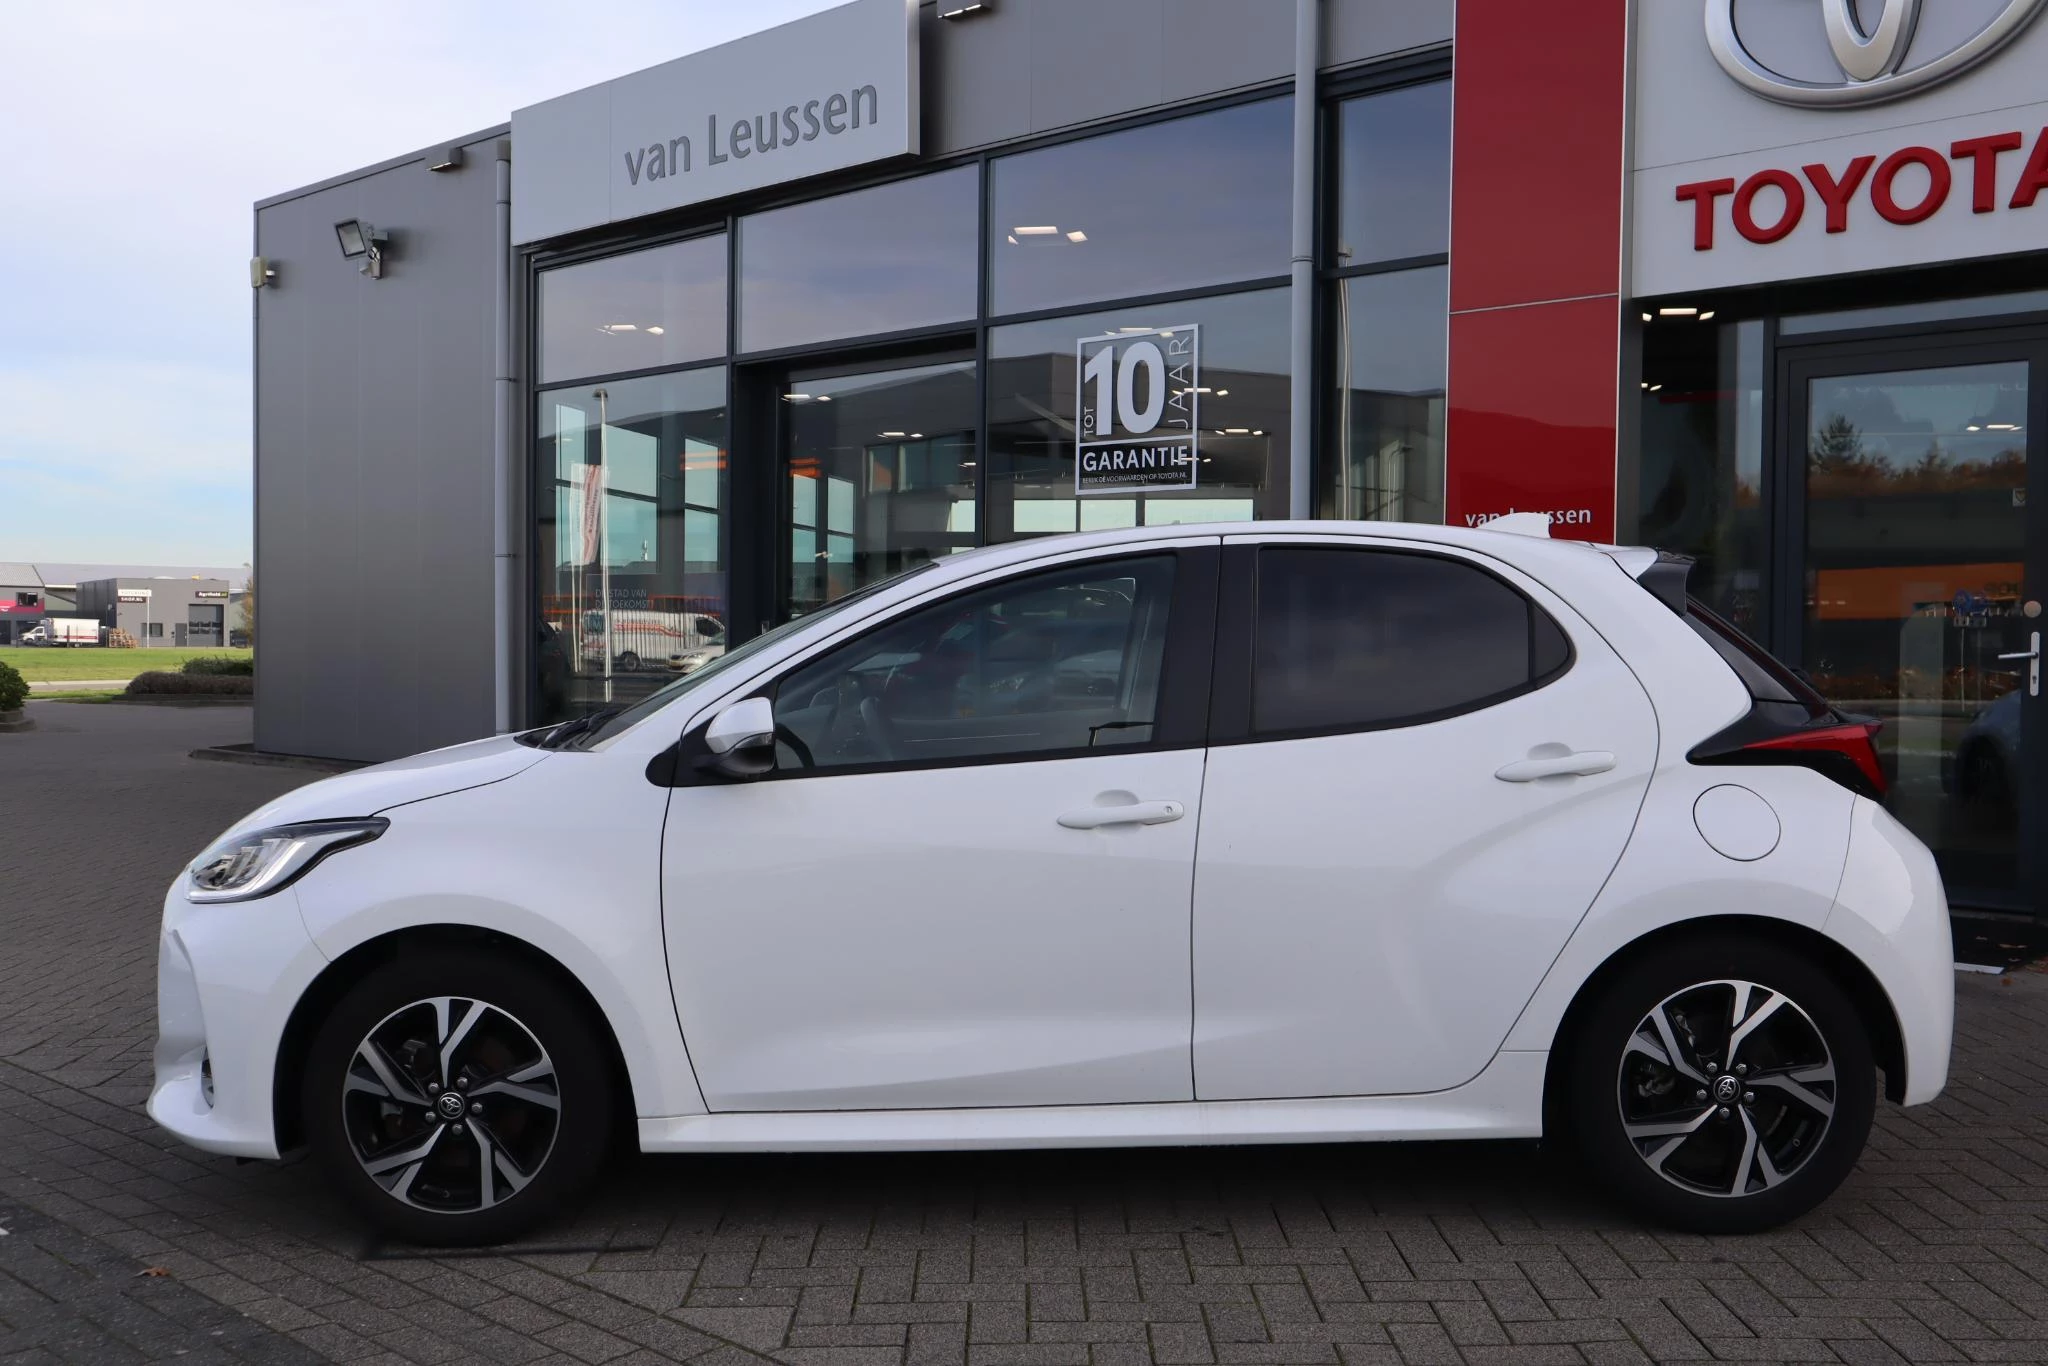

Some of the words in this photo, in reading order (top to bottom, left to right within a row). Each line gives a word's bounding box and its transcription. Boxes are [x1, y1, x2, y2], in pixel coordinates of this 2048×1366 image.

[624, 135, 691, 186] van
[708, 84, 878, 166] Leussen
[1084, 341, 1166, 436] 10
[1168, 335, 1190, 430] JAAR
[1083, 406, 1094, 437] TOT
[1083, 445, 1188, 472] GARANTIE
[1509, 507, 1592, 524] ssen
[631, 588, 647, 598] VAN
